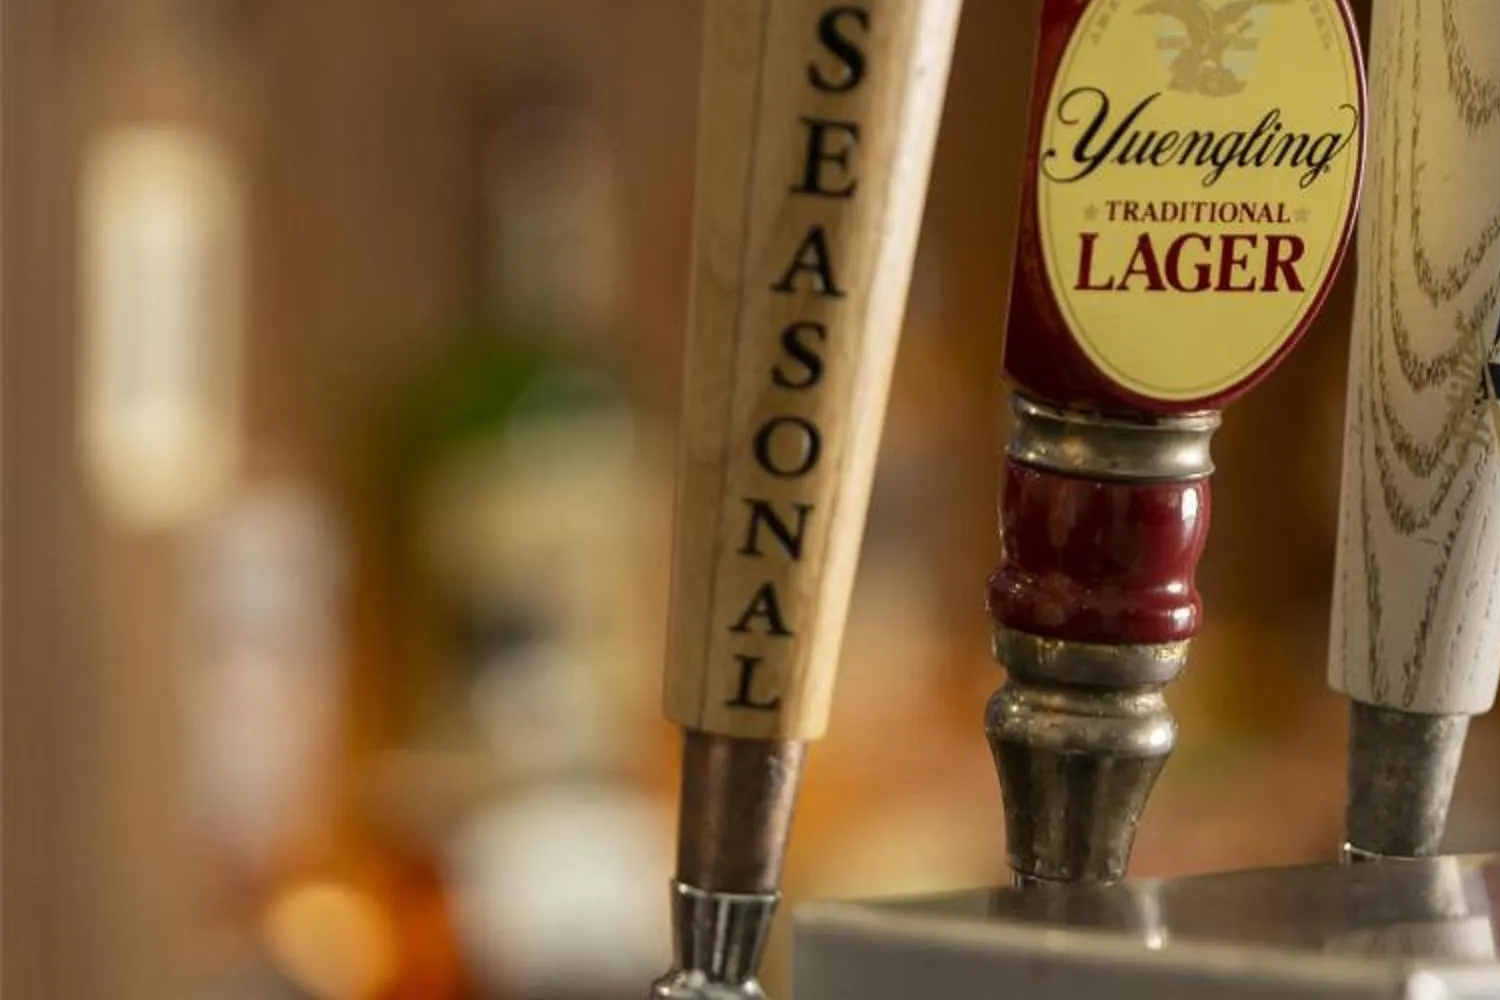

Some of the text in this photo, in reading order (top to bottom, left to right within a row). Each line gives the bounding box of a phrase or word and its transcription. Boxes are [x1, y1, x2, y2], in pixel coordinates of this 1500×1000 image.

[1041, 86, 1360, 189] Yuengling
[1104, 200, 1292, 225] TRADITIONAL
[1072, 232, 1306, 294] LAGER
[723, 5, 873, 712] SEASONAL
